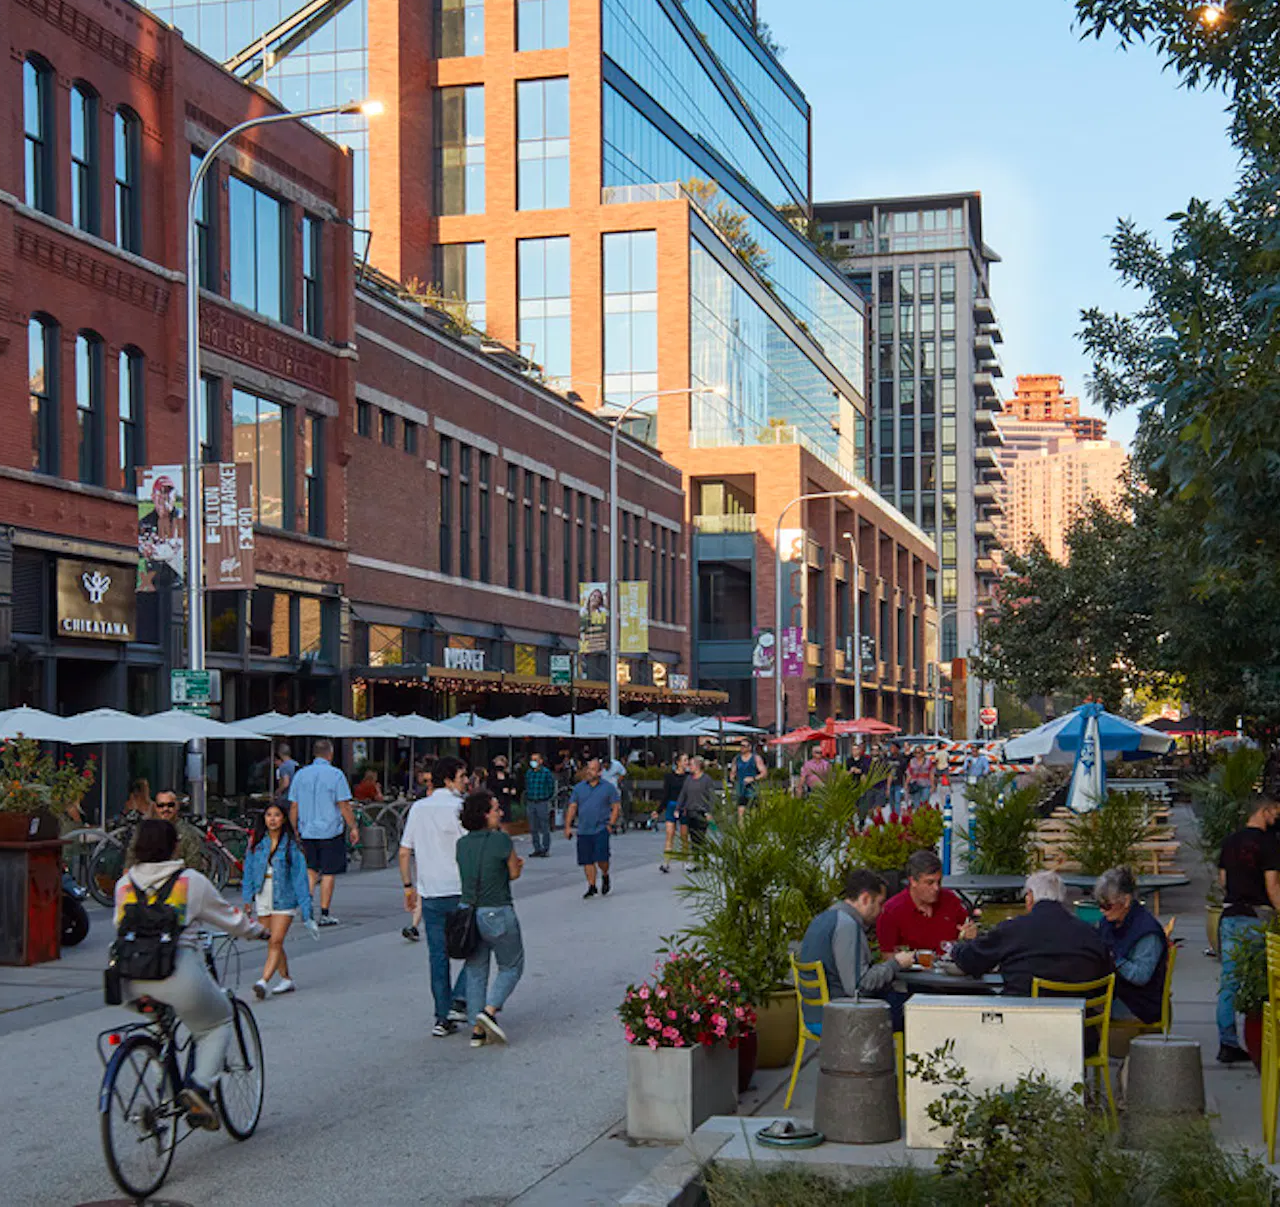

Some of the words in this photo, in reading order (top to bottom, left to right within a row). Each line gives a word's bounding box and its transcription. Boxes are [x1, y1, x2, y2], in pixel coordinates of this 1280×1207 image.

[199, 326, 264, 363] HOLESALE
[205, 486, 221, 544] FULTON
[219, 462, 238, 527] MARKET
[238, 507, 254, 550] EXPO
